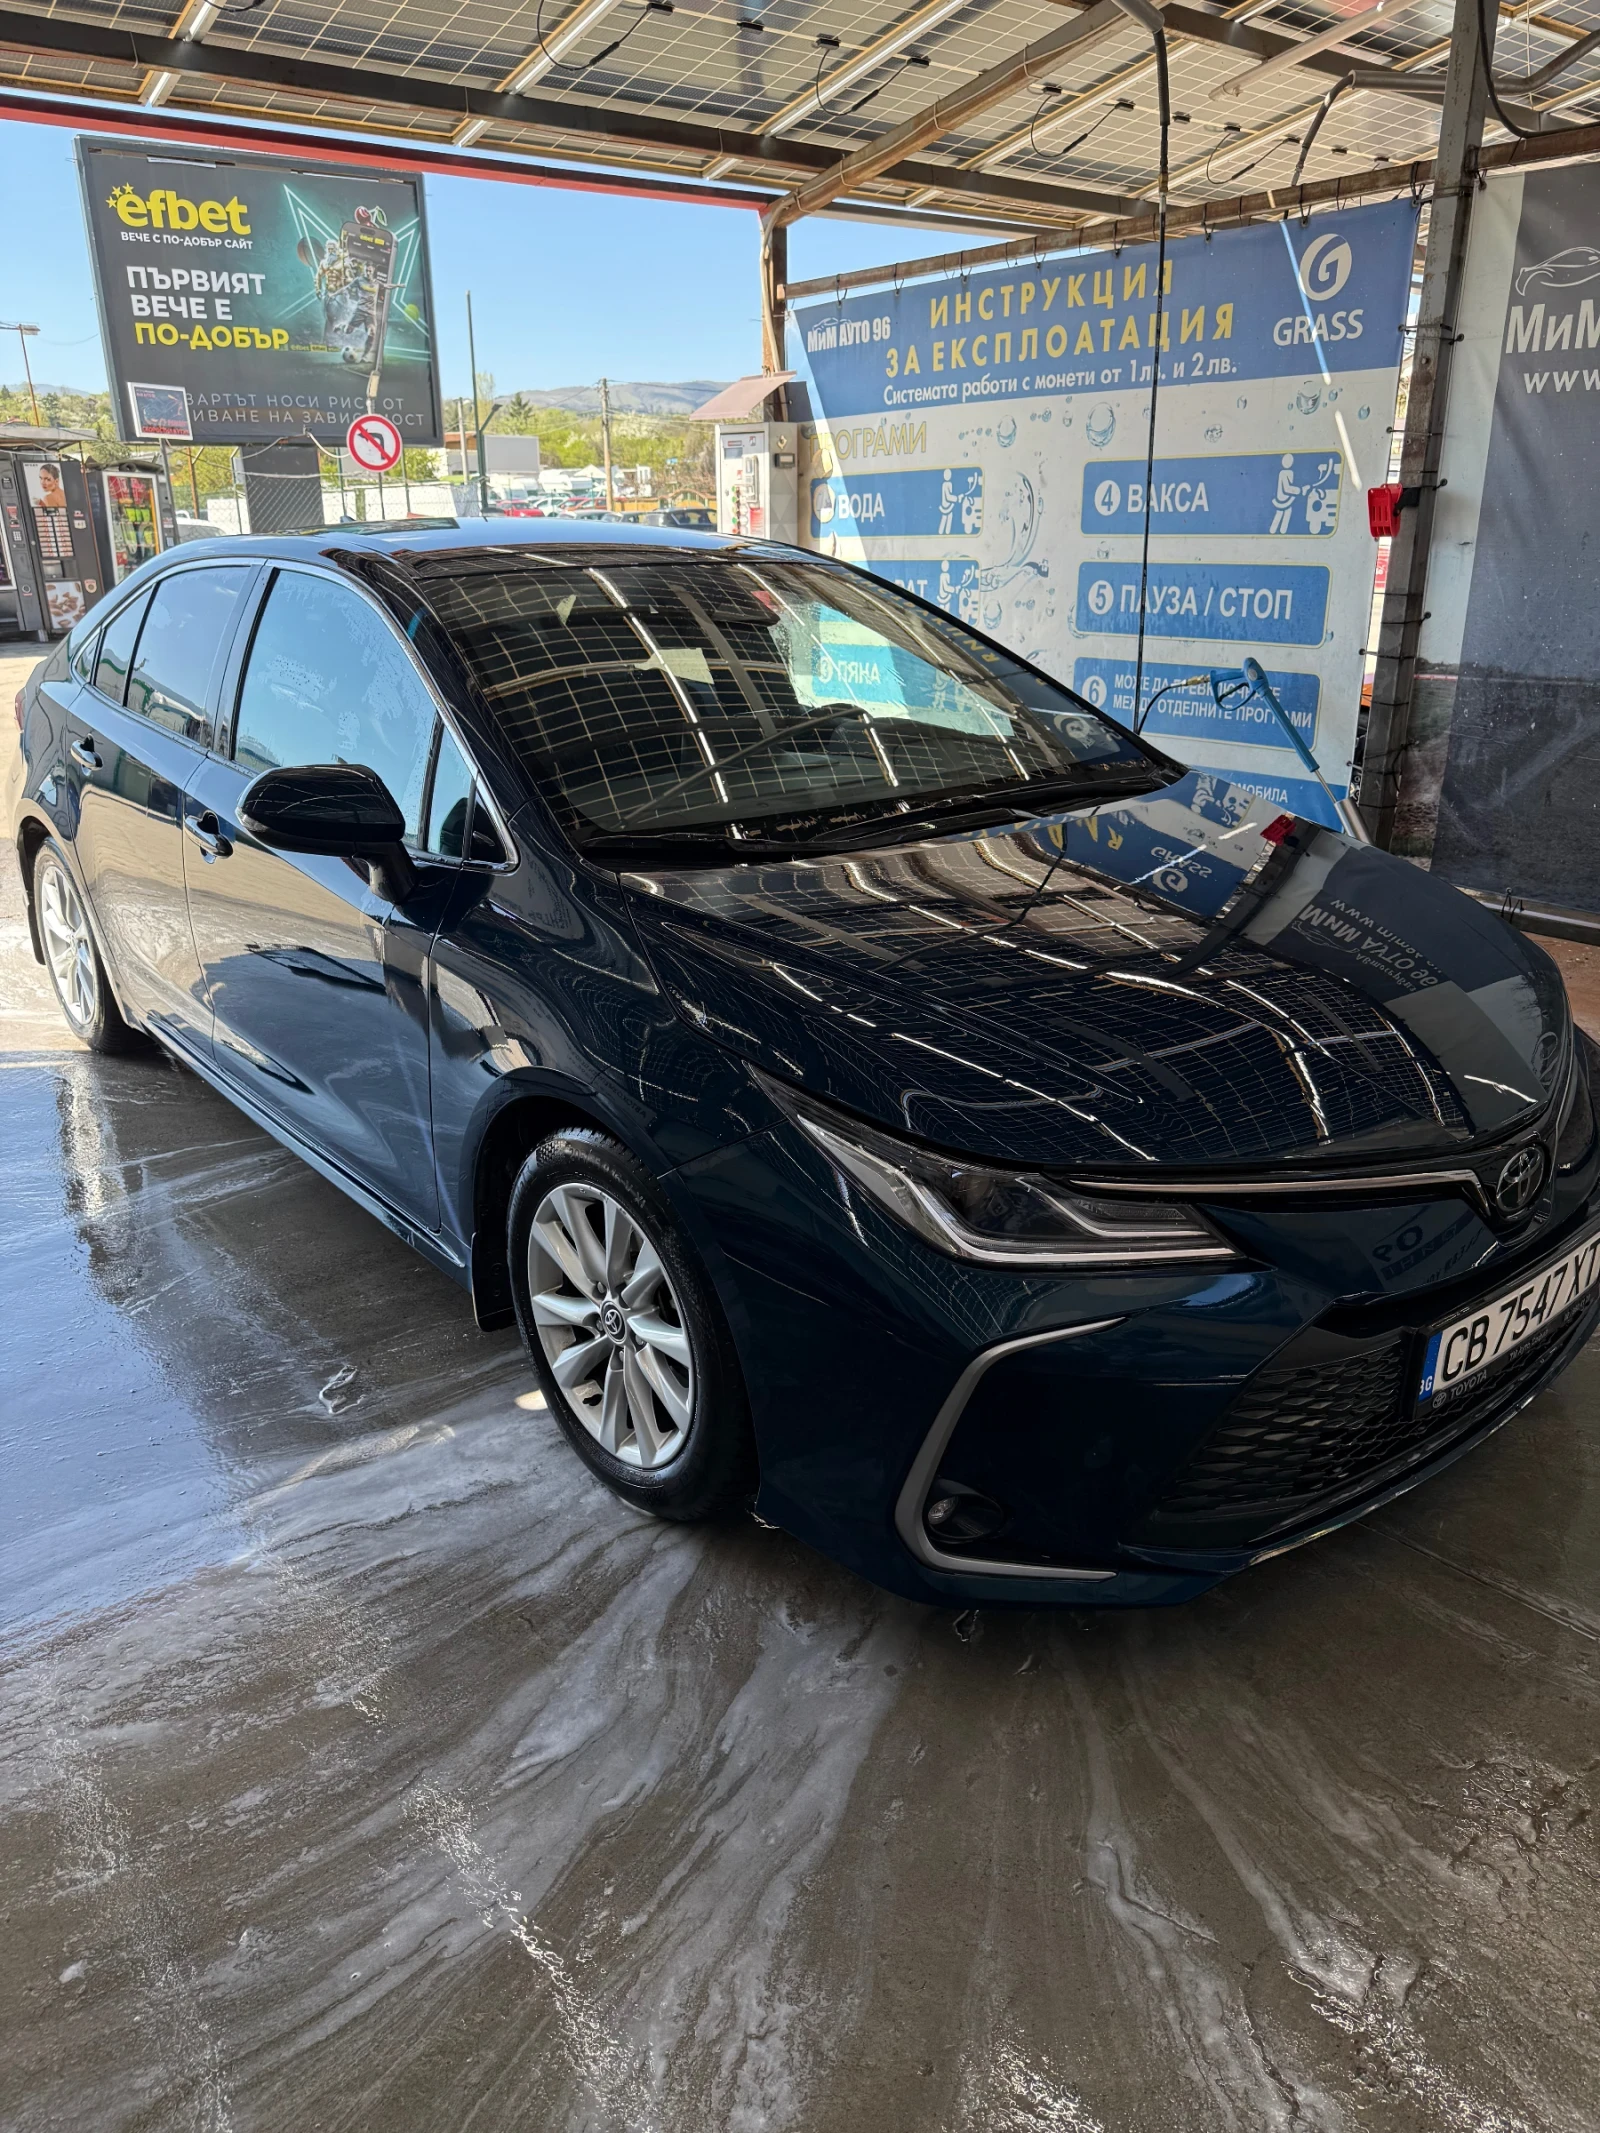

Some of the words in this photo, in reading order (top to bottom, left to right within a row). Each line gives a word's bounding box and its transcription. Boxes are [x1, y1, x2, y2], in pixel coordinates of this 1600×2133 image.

[116, 189, 251, 236] efbet
[120, 231, 151, 243] ВЕЧЕ
[152, 233, 161, 243] С
[163, 234, 222, 248] ПО-ДОБЪР
[225, 238, 254, 250] САЙТ
[126, 265, 266, 295] ПЪРВИЯТ
[930, 259, 1173, 329] ИНСТРУКЦИЯ
[130, 294, 208, 320] ВЕЧЕ
[214, 298, 233, 321] Е
[134, 322, 290, 351] ПО-ДОБЪР
[807, 325, 837, 353] МиМ
[839, 319, 869, 347] АУТО
[873, 316, 891, 342] 96
[885, 344, 921, 379] ЗА
[933, 302, 1234, 373] ЕКСПЛОАТАЦИЯ
[1273, 308, 1364, 346] GRASS
[883, 382, 958, 406] Системата
[962, 372, 1017, 403] работи
[1022, 376, 1030, 391] с
[1034, 371, 1095, 390] монети
[1100, 368, 1122, 385] от
[1173, 361, 1185, 379] и
[267, 394, 319, 409] НОСИ
[329, 396, 369, 410] РИС
[382, 397, 405, 411] ОТ
[269, 410, 294, 423] НА
[838, 492, 886, 523] ВОДА
[1101, 483, 1114, 512] 4
[1127, 481, 1209, 514] ВАКСА
[1095, 584, 1107, 611] 5
[1120, 584, 1198, 616] ПАУЗА
[1203, 586, 1215, 617] /
[1219, 586, 1293, 620] СТОП
[837, 660, 881, 685] ПЯНА
[1442, 1314, 1490, 1383] CB
[1492, 1262, 1569, 1357] 7547
[1449, 1370, 1488, 1399] TOYOTA
